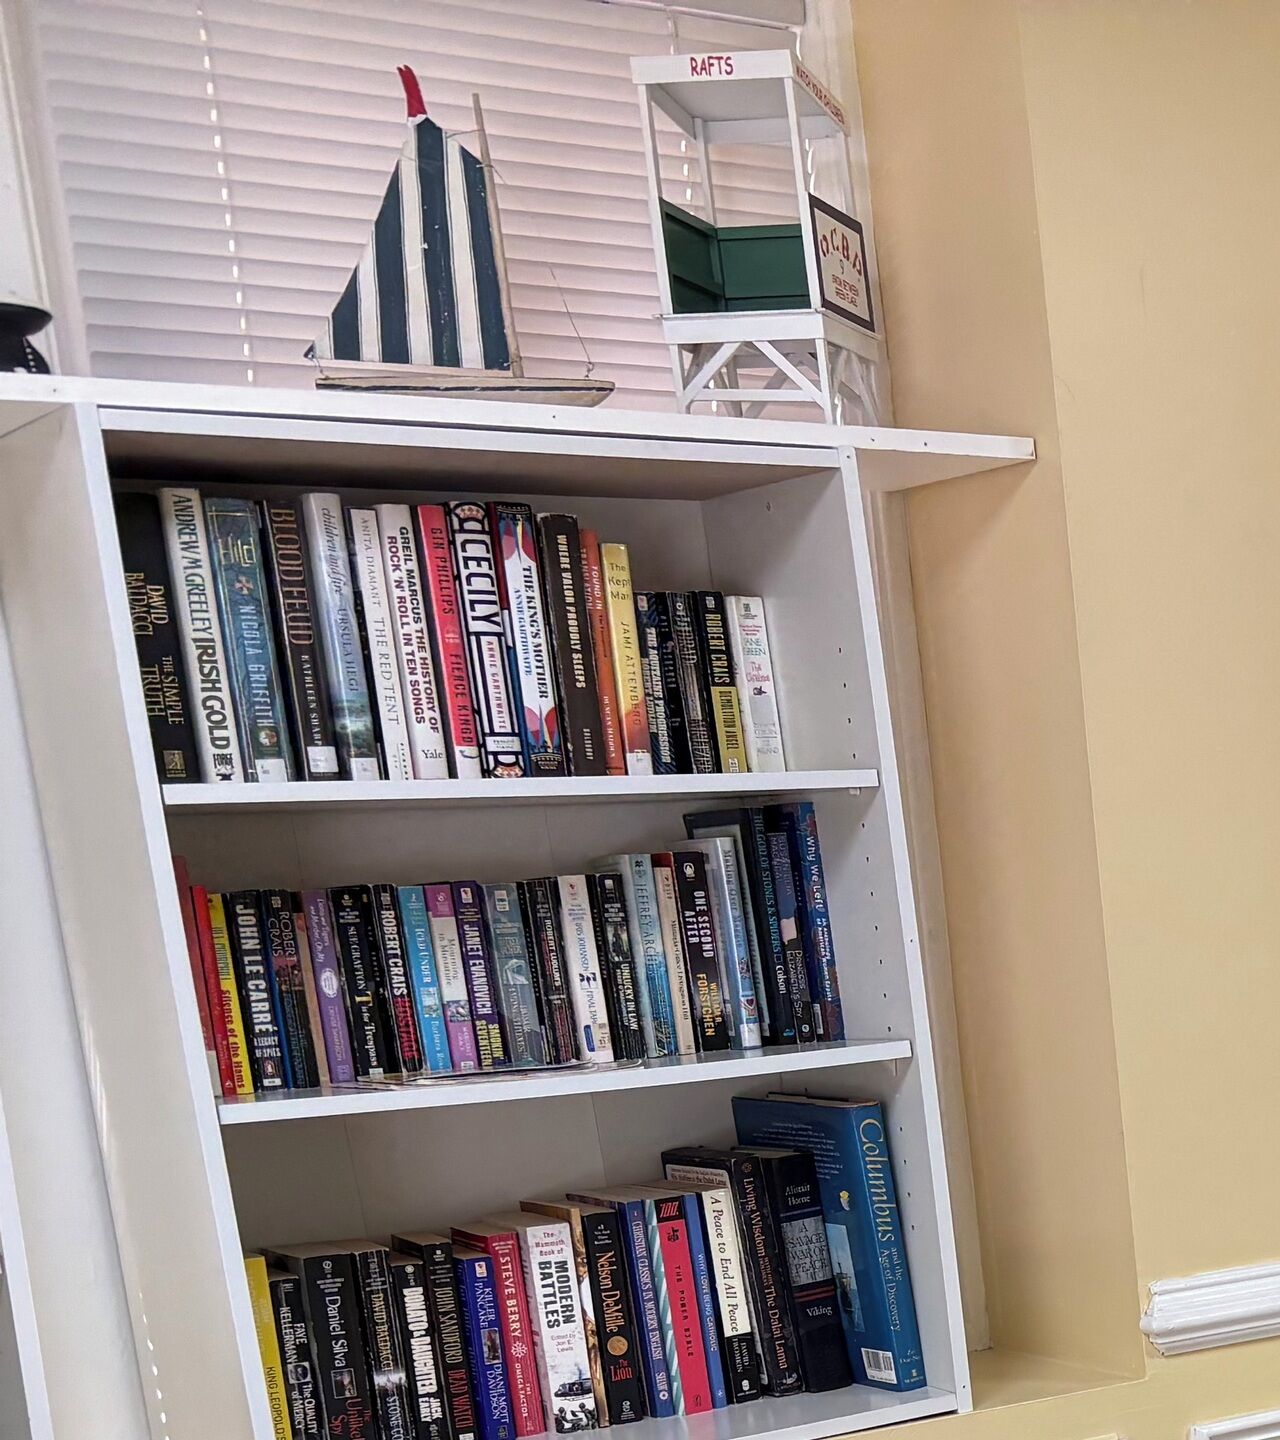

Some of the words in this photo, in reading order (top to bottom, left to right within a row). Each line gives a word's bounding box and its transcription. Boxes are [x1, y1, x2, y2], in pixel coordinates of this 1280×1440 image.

[689, 55, 735, 78] RAFTS
[172, 494, 199, 556] ANDREW
[270, 508, 304, 581] BLOOD
[361, 517, 373, 551] ANITA
[367, 556, 381, 608] DIAMANT
[387, 536, 402, 573] ROCK
[400, 526, 414, 565] GREIL
[556, 534, 571, 569] WHERE
[460, 538, 502, 629] CECILY
[522, 565, 534, 593] THE
[610, 562, 626, 572] The
[125, 572, 153, 636] BALDACCI
[146, 585, 169, 625] DAVID
[185, 574, 213, 633] GREELEY
[406, 568, 422, 625] MARCUS
[561, 572, 575, 604] VALOR
[239, 605, 263, 656] NICOLA
[282, 587, 314, 645] FEUD
[396, 595, 410, 630] ROLL
[526, 595, 541, 644] KING'S
[566, 606, 582, 650] PROUDLY
[374, 617, 388, 648] THE
[402, 633, 413, 647] IN
[415, 627, 427, 653] THE
[621, 621, 632, 650] JAMI
[705, 613, 726, 651] ROBERT
[162, 655, 174, 672] THE
[191, 637, 223, 692] IRISH
[379, 653, 393, 681] RED
[404, 649, 418, 676] TEN
[572, 652, 586, 689] SLEEPS
[711, 654, 731, 683] CRAIS
[141, 664, 166, 716] TRUTH
[162, 675, 184, 725] SIMPLE
[248, 664, 275, 727] GRIFFITH
[410, 679, 425, 725] SONGS
[420, 658, 437, 715] HISTORY
[625, 655, 642, 727] ATTENBERG
[201, 695, 231, 750] GOLD
[384, 686, 400, 725] TENT
[429, 717, 439, 734] OF
[422, 749, 444, 759] Yale
[806, 836, 816, 862] Why
[810, 865, 820, 882] We
[694, 890, 707, 912] ONE
[236, 904, 261, 950] JOHN
[268, 918, 284, 957] CRAIS
[279, 911, 297, 962] ROBERT
[381, 910, 401, 956] ROBERT
[464, 924, 483, 957] JANET
[684, 911, 699, 944] AFTER
[697, 916, 714, 958] SECOND
[243, 956, 264, 974] LE
[388, 958, 408, 996] CRAIS
[621, 963, 634, 1001] UNLUCKY
[247, 979, 278, 1033] CARRÉ
[469, 960, 493, 1015] EVANOVICH
[221, 989, 234, 1024] Silence
[227, 1028, 238, 1038] of
[230, 1041, 241, 1059] the
[743, 1177, 756, 1212] Living
[860, 1118, 897, 1242] Columbus
[710, 1195, 722, 1205] A
[788, 1196, 811, 1206] Horne
[712, 1208, 724, 1239] Peace
[749, 1212, 766, 1257] Wisdom
[718, 1242, 726, 1254] to
[880, 1250, 890, 1267] Age
[500, 1256, 516, 1296] STEVE
[596, 1250, 617, 1289] Nelson
[720, 1257, 735, 1281] End
[884, 1267, 893, 1281] of
[402, 1286, 429, 1331] DONATO
[433, 1286, 456, 1312] JOHN
[538, 1260, 560, 1329] BATTLES
[553, 1260, 577, 1325] MODERN
[724, 1282, 738, 1299] All
[765, 1286, 777, 1307] The
[887, 1283, 902, 1332] Discovery
[325, 1295, 346, 1336] Daniel
[506, 1299, 522, 1337] BERRY
[601, 1290, 625, 1333] DeMille
[727, 1303, 739, 1333] Peace
[768, 1309, 783, 1339] Dalai
[806, 1305, 833, 1317] Viking
[279, 1306, 298, 1363] KELLERMAN
[293, 1322, 307, 1345] FAYE
[439, 1313, 464, 1364] SANDFORD
[331, 1339, 349, 1367] Silva
[410, 1336, 438, 1395] DAUGHTER
[774, 1340, 788, 1369] Lama
[266, 1366, 278, 1390] KING
[493, 1363, 506, 1394] DIANE
[610, 1365, 633, 1382] Lion
[304, 1398, 318, 1434] QUALITY
[499, 1394, 510, 1424] MOTT
